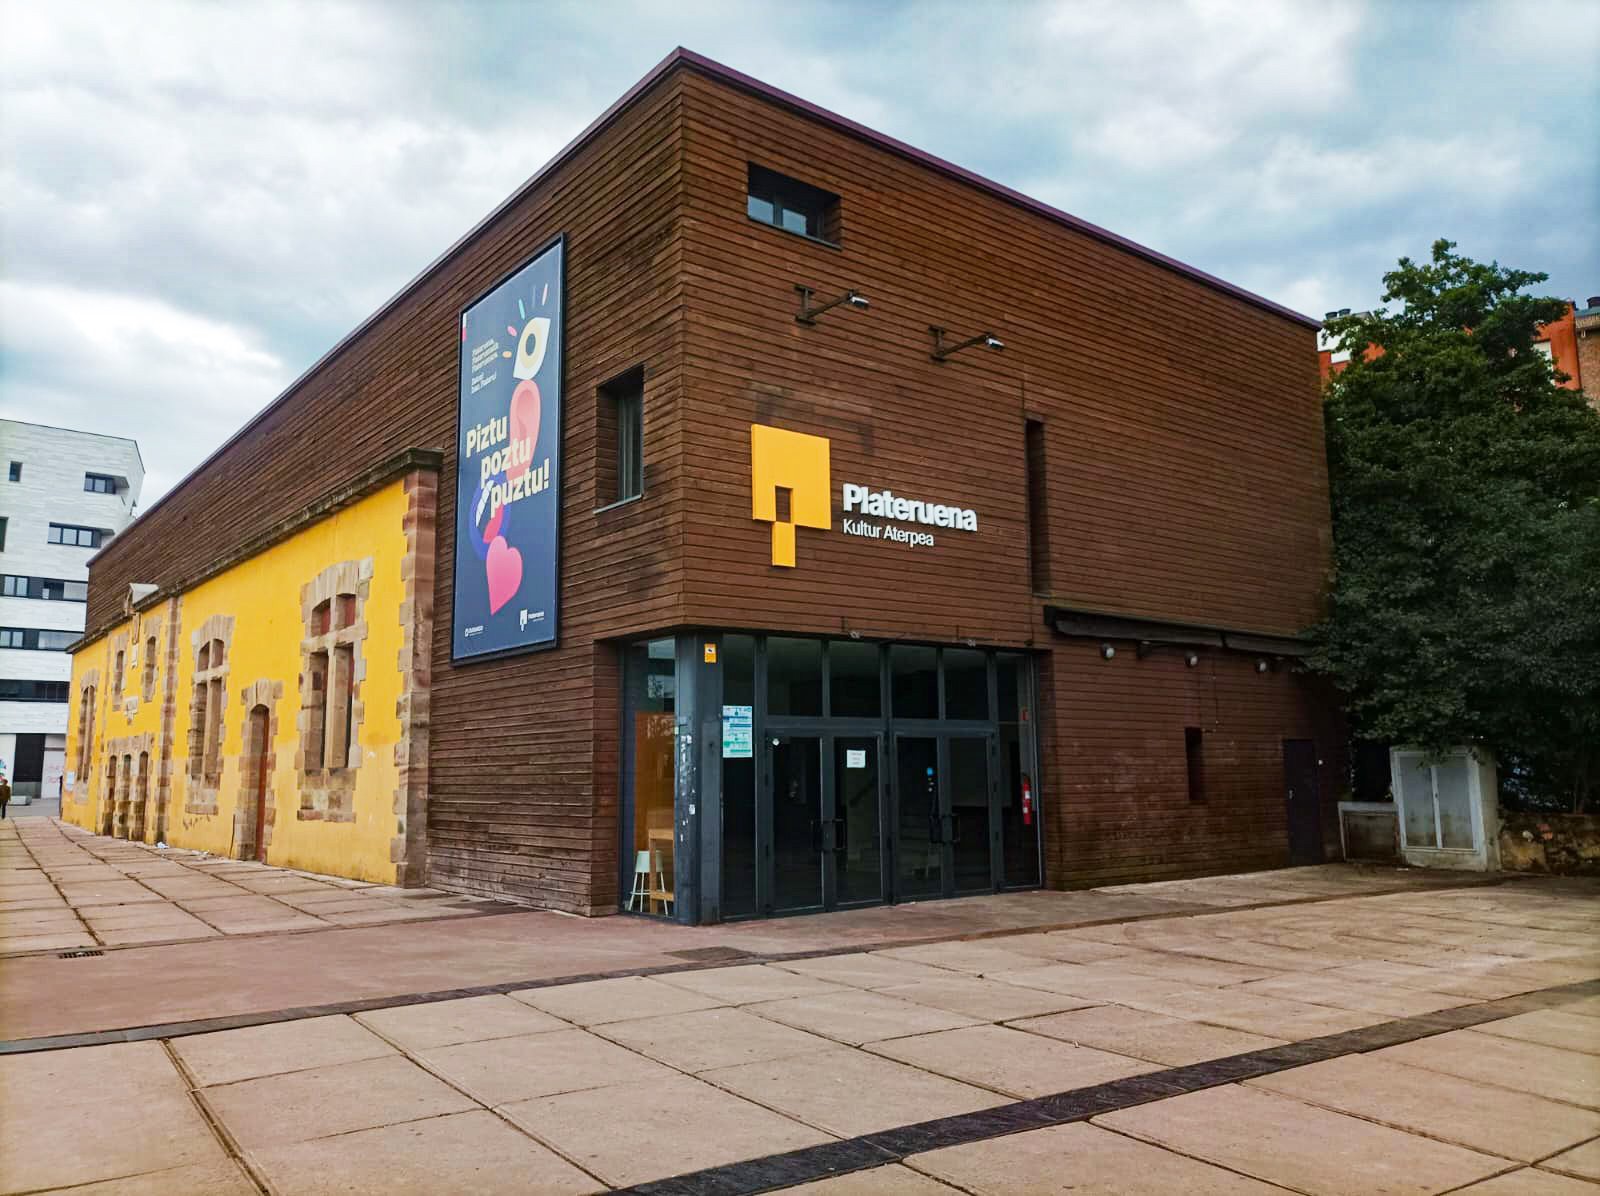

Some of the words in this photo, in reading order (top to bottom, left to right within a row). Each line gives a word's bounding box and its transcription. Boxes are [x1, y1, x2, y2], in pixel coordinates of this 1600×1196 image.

[465, 416, 508, 458] Piztu
[480, 437, 531, 489] poztu
[490, 458, 550, 519] puztu!
[842, 483, 978, 531] Plateruena
[843, 518, 882, 538] Kultur
[883, 525, 934, 548] Aterpea
